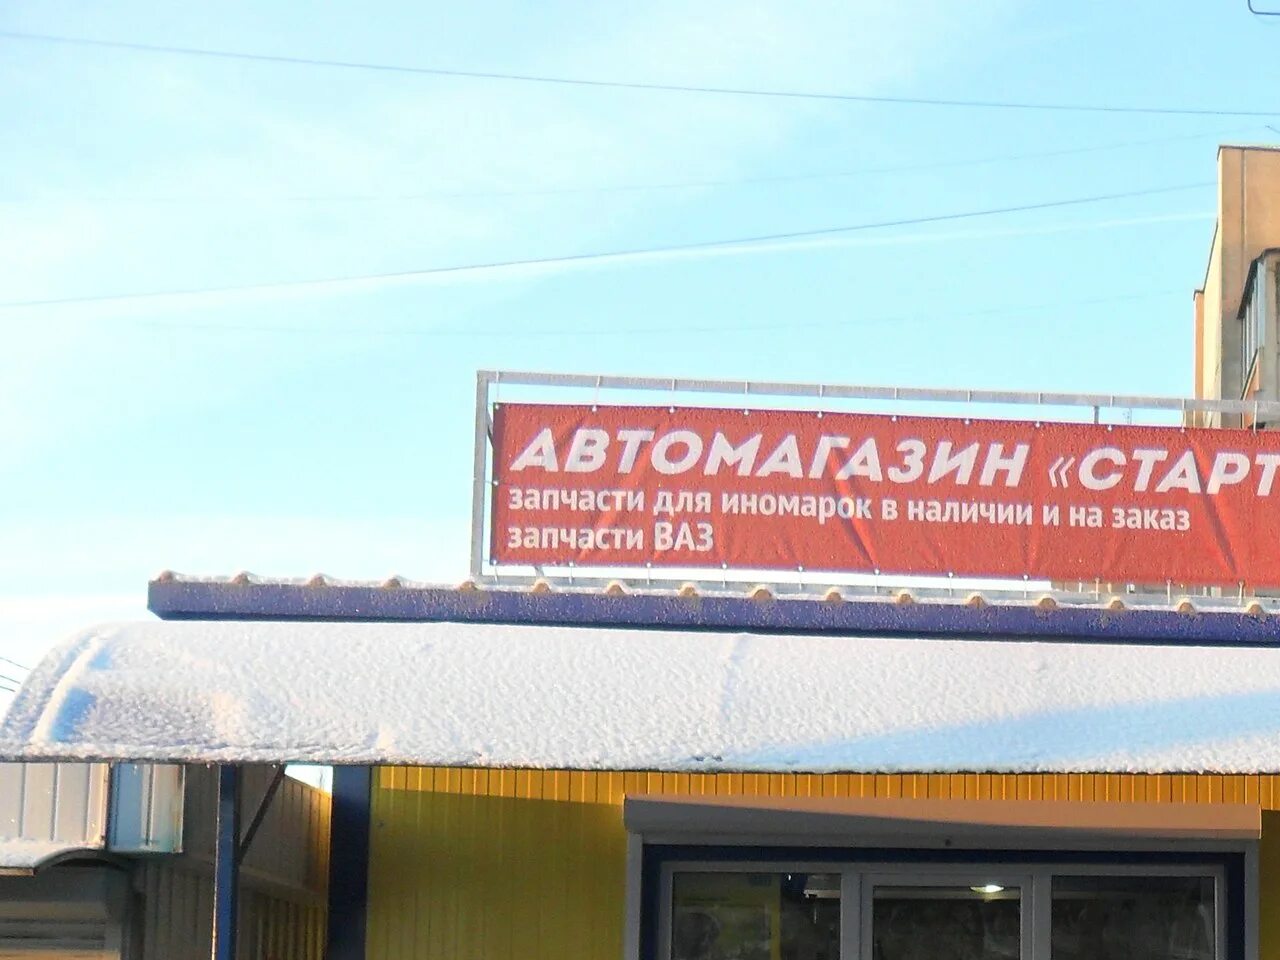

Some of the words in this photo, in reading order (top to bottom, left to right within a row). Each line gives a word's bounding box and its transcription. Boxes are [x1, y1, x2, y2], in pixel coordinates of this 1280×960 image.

[507, 424, 1031, 488] АВТОМАГАЗИН
[508, 485, 645, 515] запчасти
[652, 488, 712, 519] для
[721, 490, 873, 523] иномарок
[880, 497, 899, 521] в
[907, 498, 1034, 526] наличии
[1042, 503, 1060, 527] и
[1069, 504, 1104, 529] на
[1111, 506, 1191, 532] заказ
[507, 522, 645, 554] запчасти
[653, 519, 714, 553] ВАЗ
